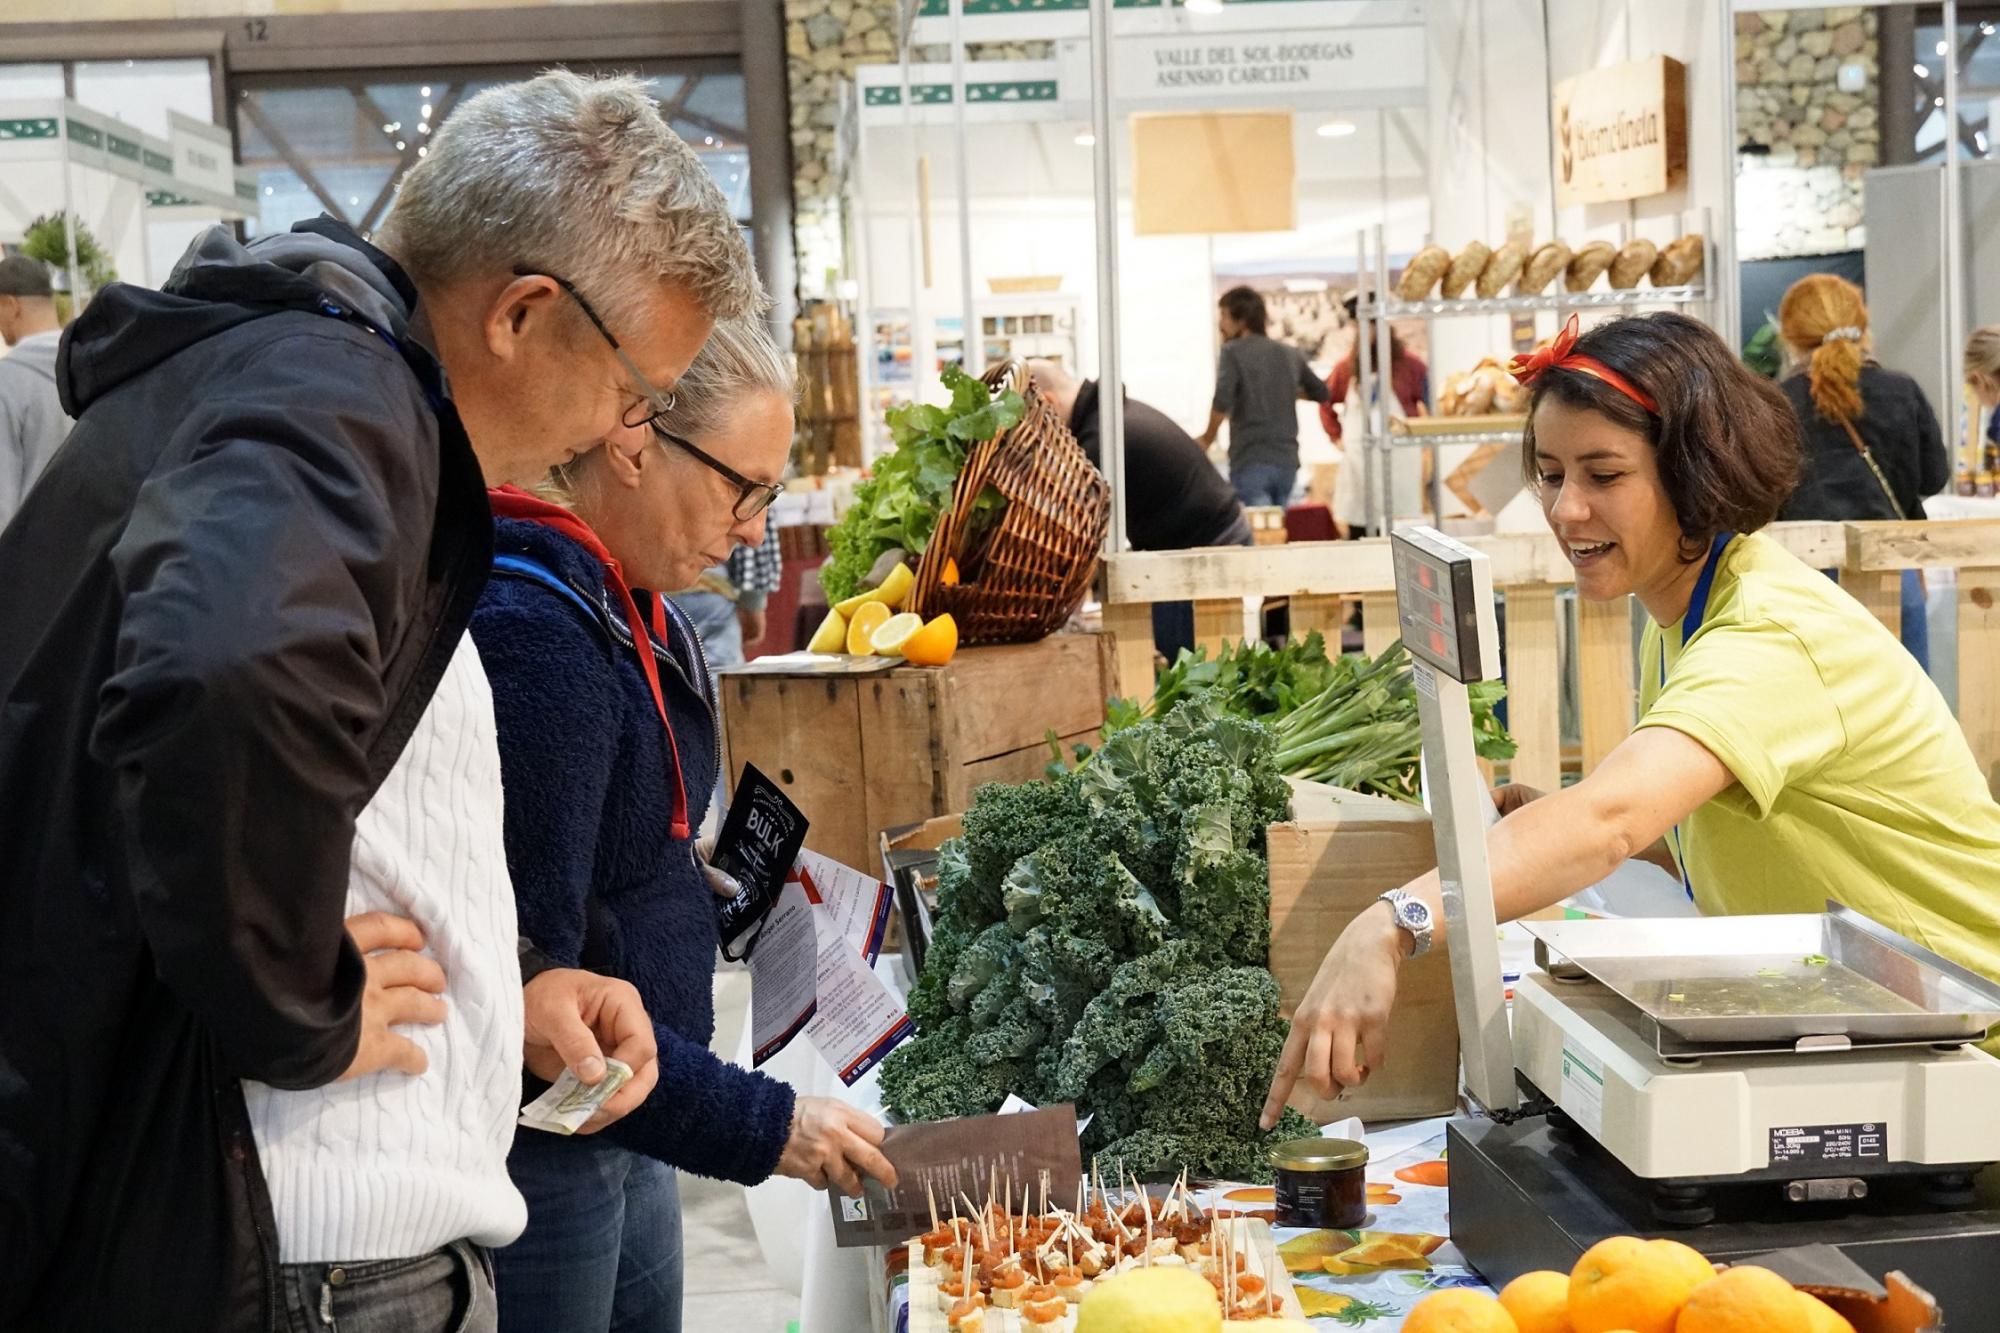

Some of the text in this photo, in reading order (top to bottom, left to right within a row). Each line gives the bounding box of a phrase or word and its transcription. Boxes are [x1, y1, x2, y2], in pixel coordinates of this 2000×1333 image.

[244, 19, 269, 42] 12
[1153, 47, 1201, 67] VALLE
[1207, 46, 1236, 65] DEL
[1155, 68, 1224, 88] ASENSIO
[746, 807, 785, 859] BULK
[774, 904, 797, 926] Serrano
